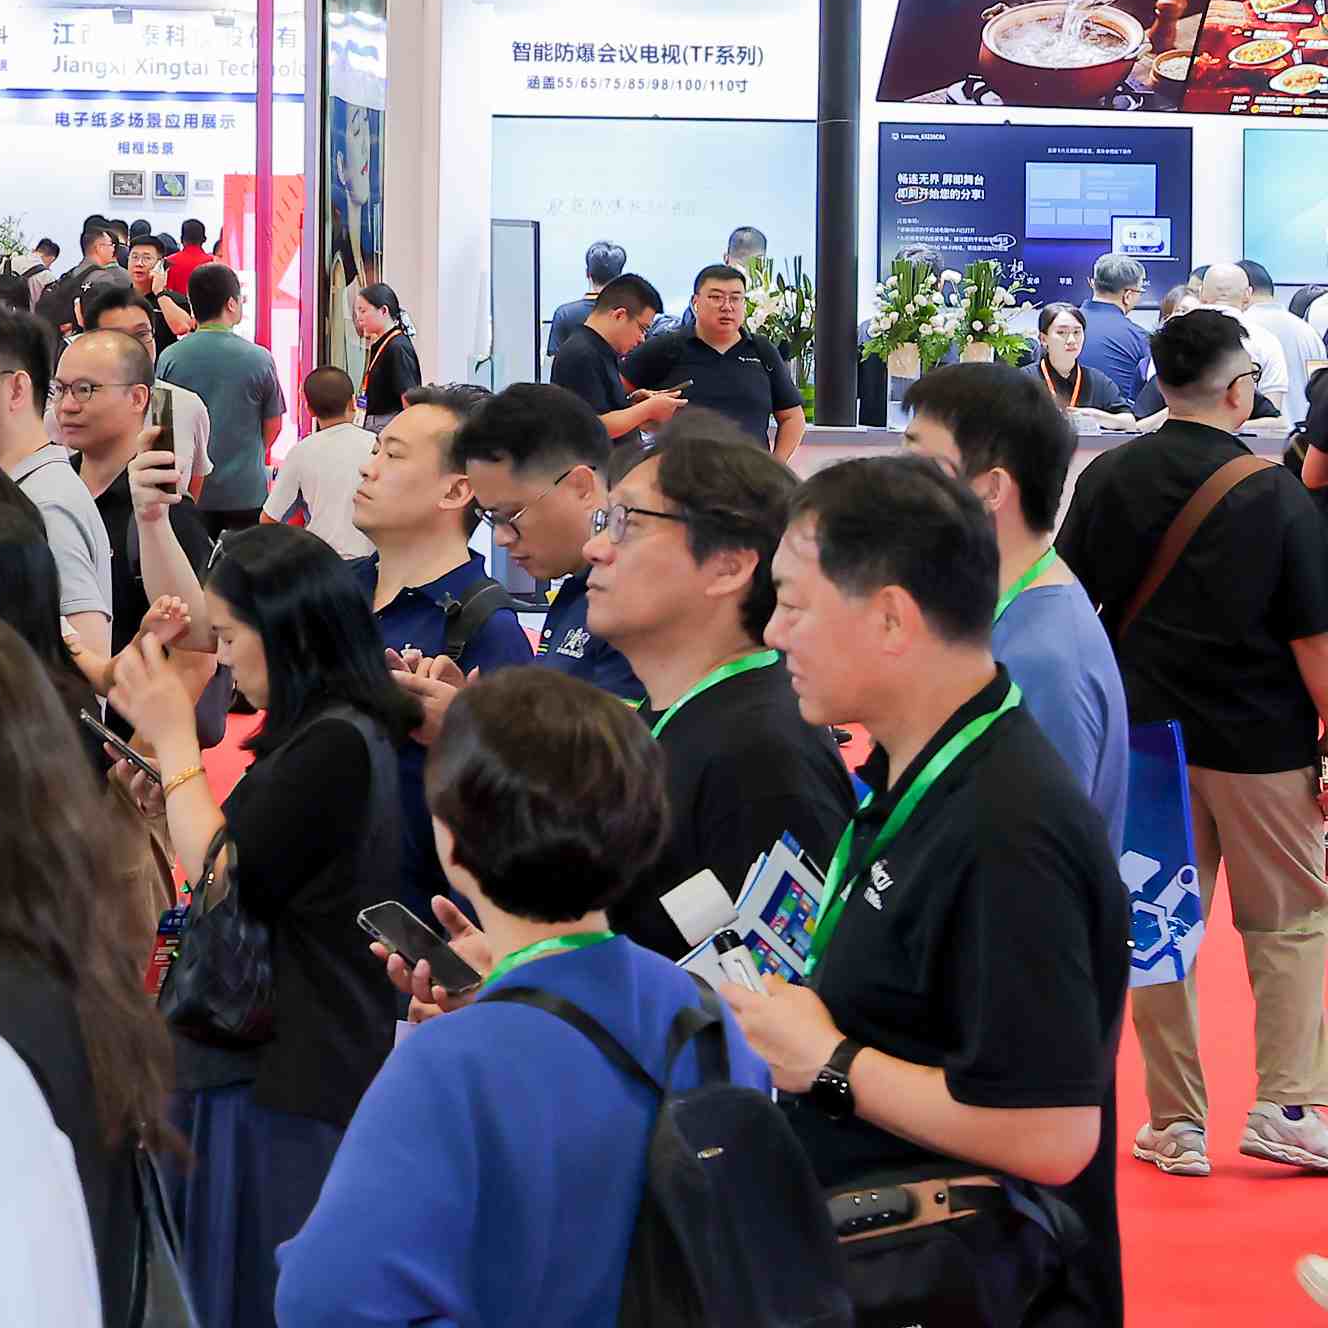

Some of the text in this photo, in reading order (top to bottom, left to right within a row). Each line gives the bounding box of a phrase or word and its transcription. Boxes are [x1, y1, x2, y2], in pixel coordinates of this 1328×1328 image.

[512, 41, 764, 67] 智能防爆会议电视(TF系列)
[52, 55, 126, 79] Jiangxi
[135, 58, 208, 80] Xingtai
[526, 75, 748, 93] 涵盖55/65/75/85/98/100/110寸
[55, 112, 236, 129] 电子纸多场景应用展示
[118, 141, 174, 154] 相框场景
